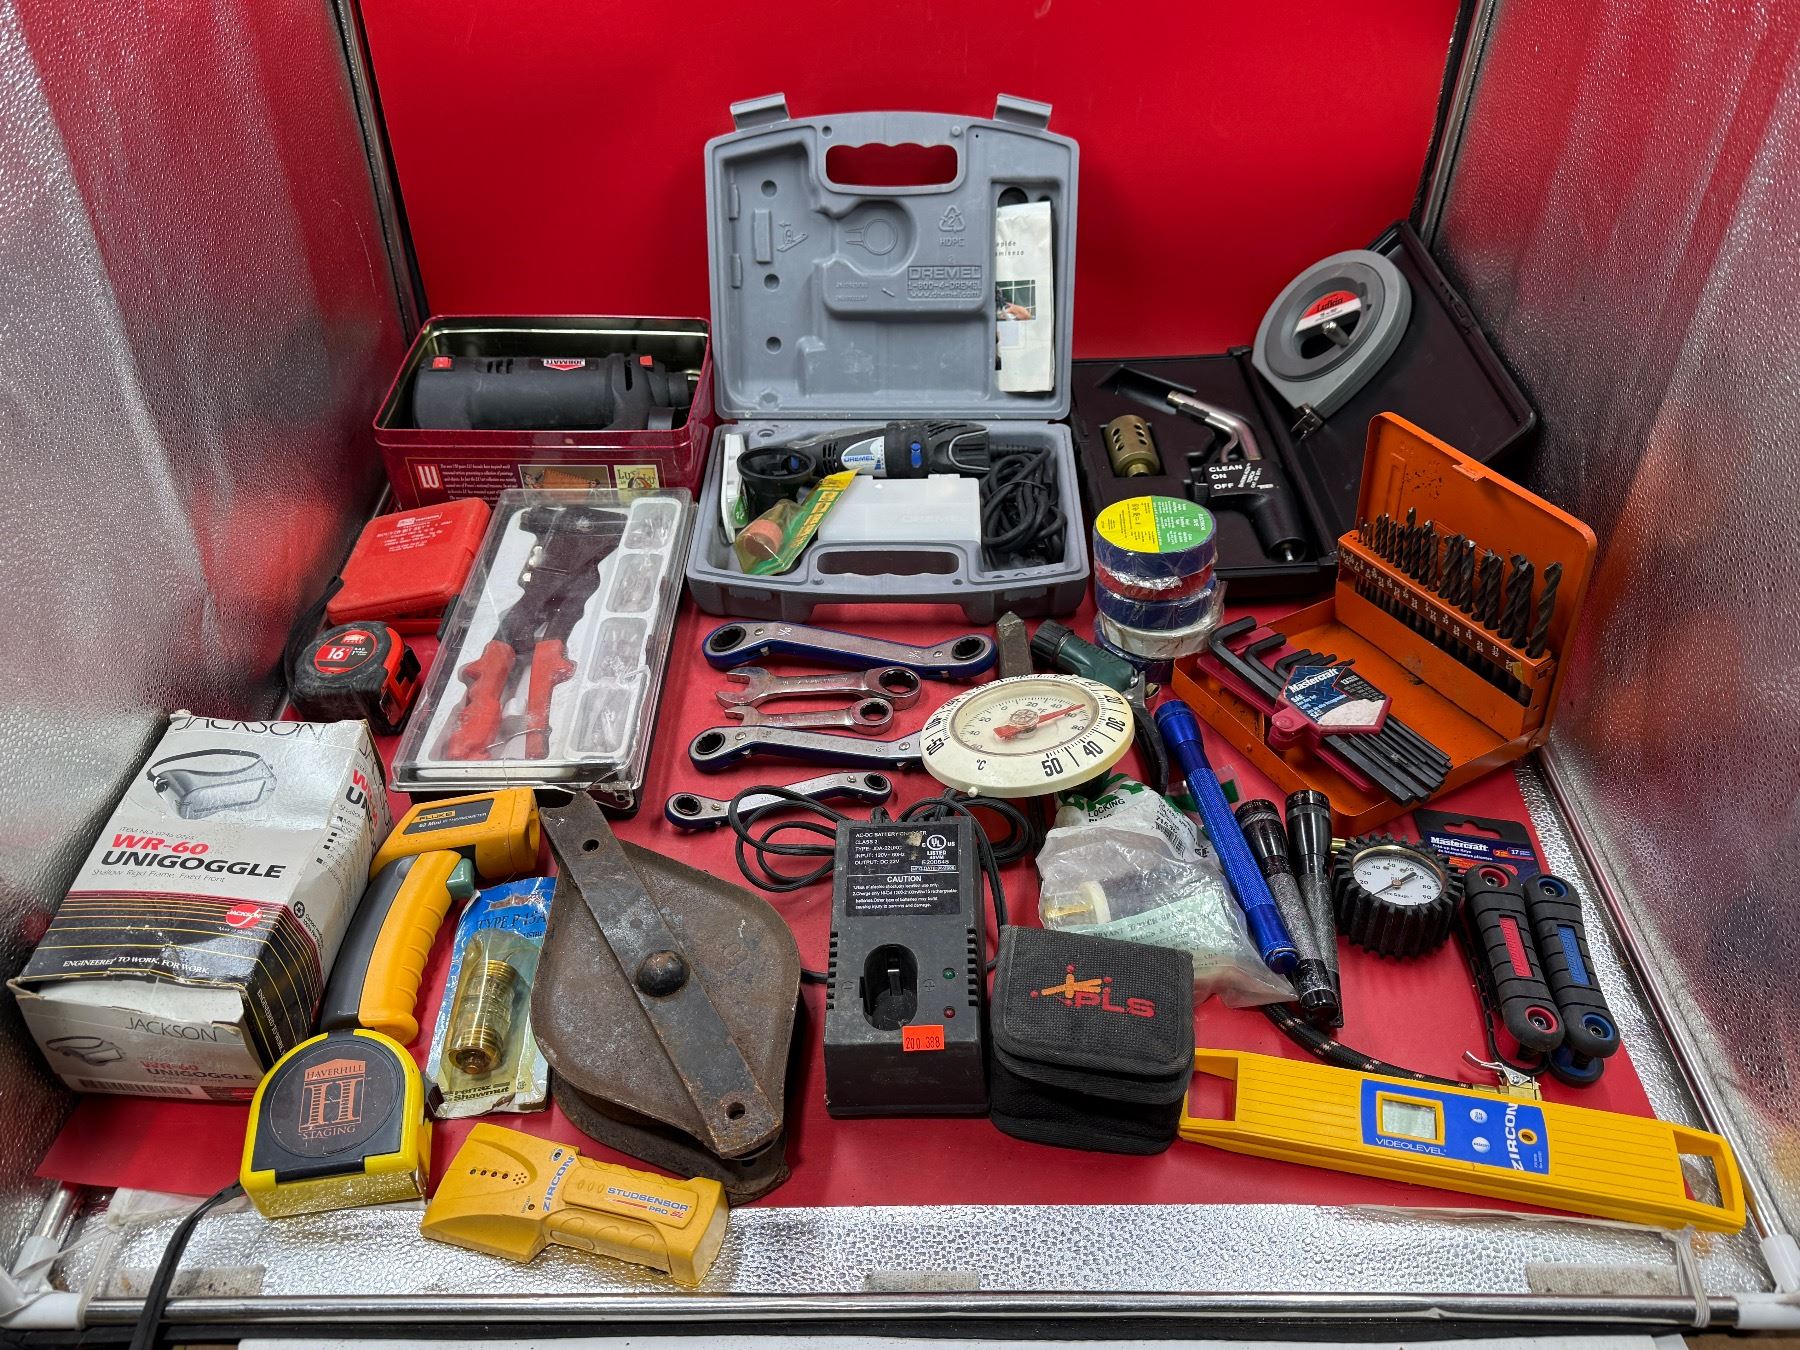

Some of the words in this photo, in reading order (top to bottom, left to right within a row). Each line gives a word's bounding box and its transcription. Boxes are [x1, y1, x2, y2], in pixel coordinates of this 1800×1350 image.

[940, 238, 965, 247] HDPE
[909, 266, 981, 280] DREMEL
[1317, 297, 1343, 312] Lufkin
[843, 454, 876, 463] DREMEL
[1208, 464, 1243, 472] CLEAN
[1213, 482, 1234, 490] OFF
[1288, 668, 1340, 694] Mastercraft
[1103, 693, 1124, 705] 20
[1071, 724, 1085, 732] 80
[1105, 716, 1126, 733] 30
[1084, 740, 1104, 758] 40
[1041, 758, 1064, 777] 50
[1088, 798, 1126, 818] LOCKING
[419, 811, 453, 821] FLUKE
[112, 833, 210, 856] WR-60
[1430, 836, 1489, 852] Mastercraft
[101, 850, 287, 880] UNIGOGGLE
[91, 868, 123, 877] Shallow
[126, 869, 147, 879] Rigid
[179, 872, 201, 881] Fixed
[203, 874, 226, 883] Front
[886, 875, 922, 883] CAUTION
[477, 915, 509, 929] TYPE
[511, 913, 520, 927] P
[1093, 929, 1123, 938] BRYANT
[62, 957, 115, 968] ENGINEERE
[161, 959, 181, 969] FOR
[1075, 992, 1156, 1018] PLS
[125, 1016, 218, 1043] JACKSON
[906, 1037, 921, 1050] 200
[141, 1060, 200, 1071] WR-60
[306, 1064, 364, 1080] HAVERHILL
[146, 1067, 256, 1081] UNIGOGGLE
[453, 1086, 509, 1102] Shawmut
[454, 1084, 492, 1096] Ferraz
[302, 1124, 356, 1140] STAGING
[1504, 1102, 1525, 1171] ZIRCON
[1375, 1137, 1446, 1156] VIDEOLEVEL
[543, 1154, 576, 1212] ZIRCON
[607, 1186, 689, 1212] STUDSENSOR
[648, 1204, 668, 1216] PRO
